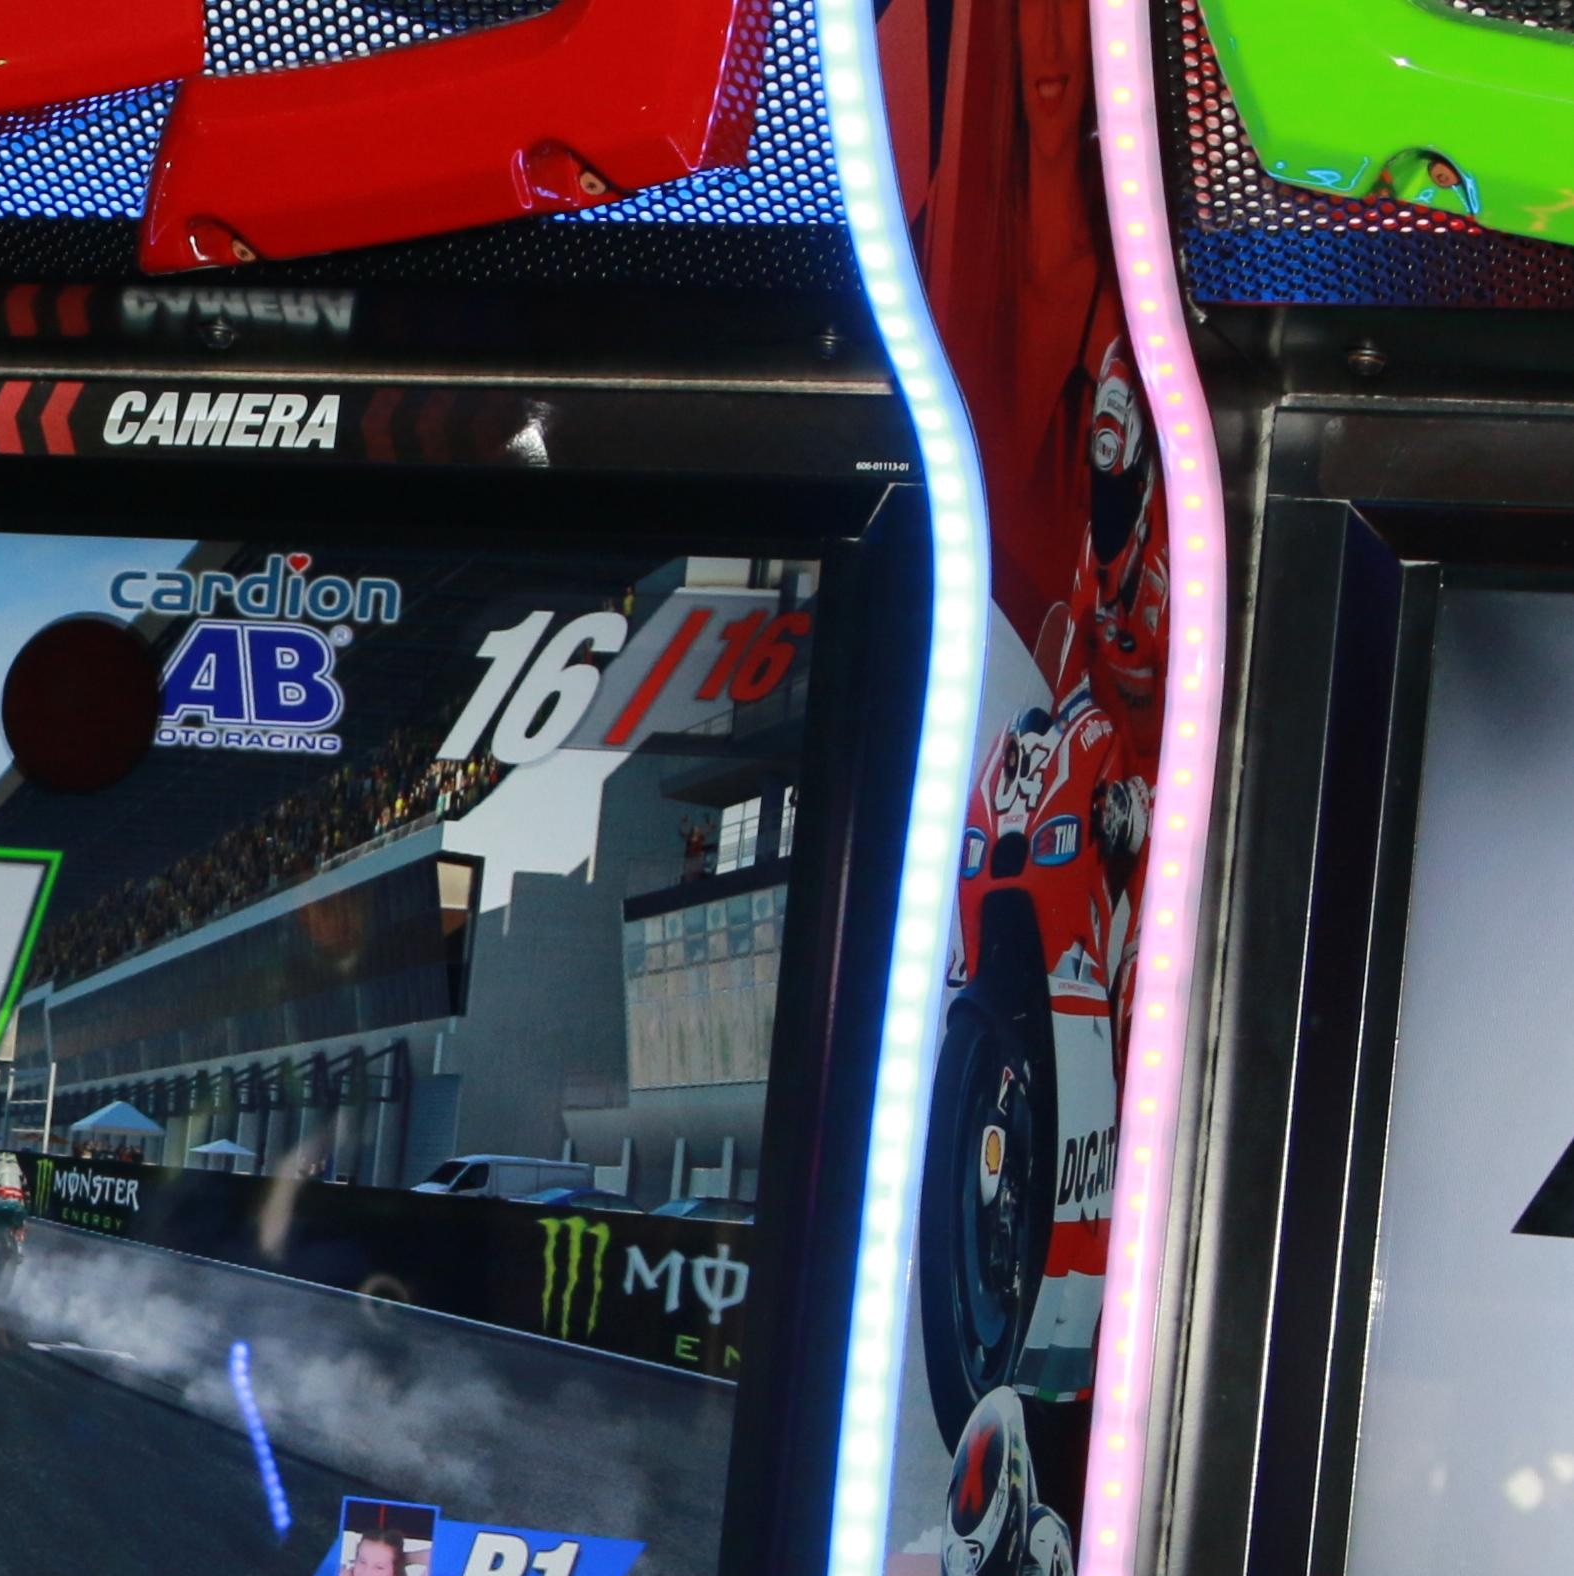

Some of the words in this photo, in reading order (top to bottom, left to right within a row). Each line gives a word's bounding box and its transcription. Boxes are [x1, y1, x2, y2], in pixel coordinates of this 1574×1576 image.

[102, 390, 341, 450] CAMERA
[108, 552, 402, 624] cardion
[154, 726, 219, 747] OTO
[223, 730, 343, 754] RACING
[1054, 824, 1078, 855] TIM
[53, 1165, 140, 1211] MONSTER
